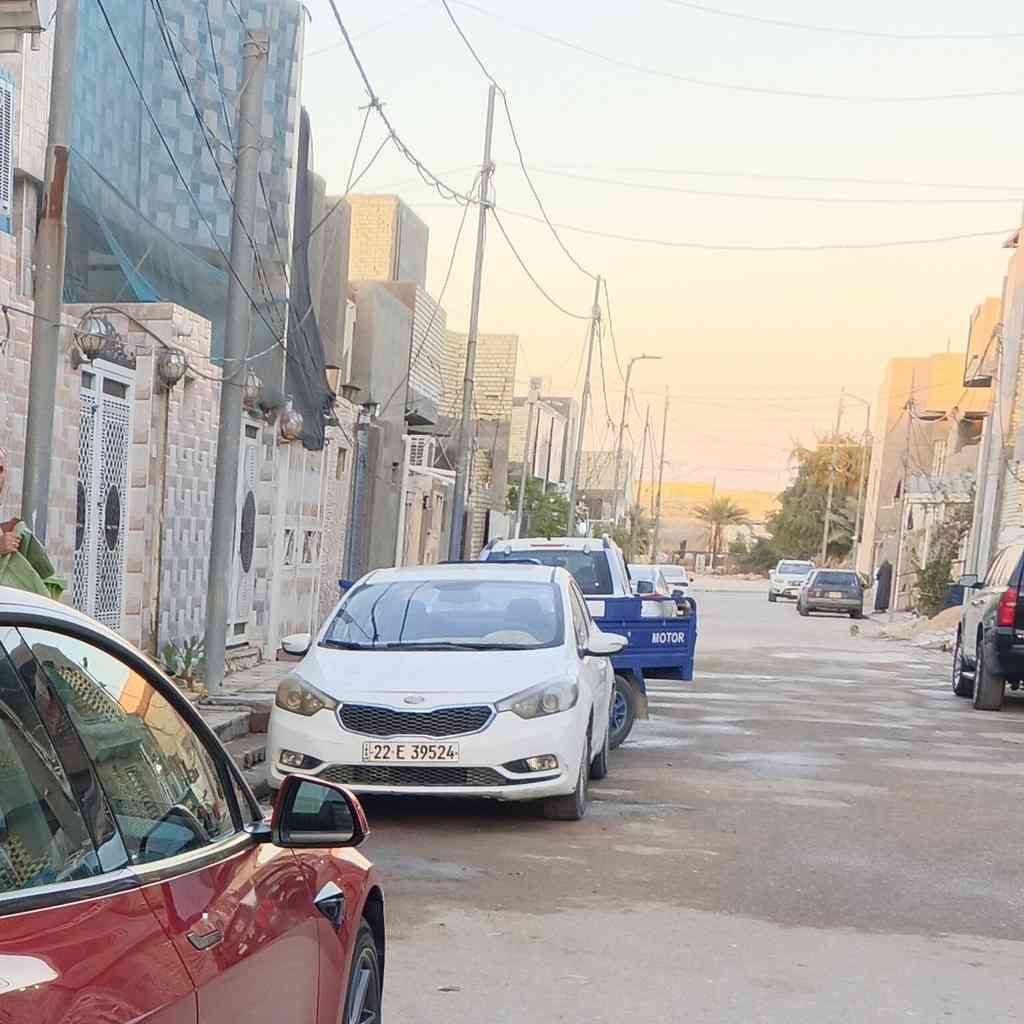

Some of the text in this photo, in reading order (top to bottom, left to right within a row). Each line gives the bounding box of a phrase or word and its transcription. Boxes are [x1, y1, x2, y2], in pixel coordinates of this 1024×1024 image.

[651, 632, 685, 643] MOTOR
[373, 744, 391, 760] 22
[396, 744, 406, 760] E
[411, 744, 455, 760] 39524
